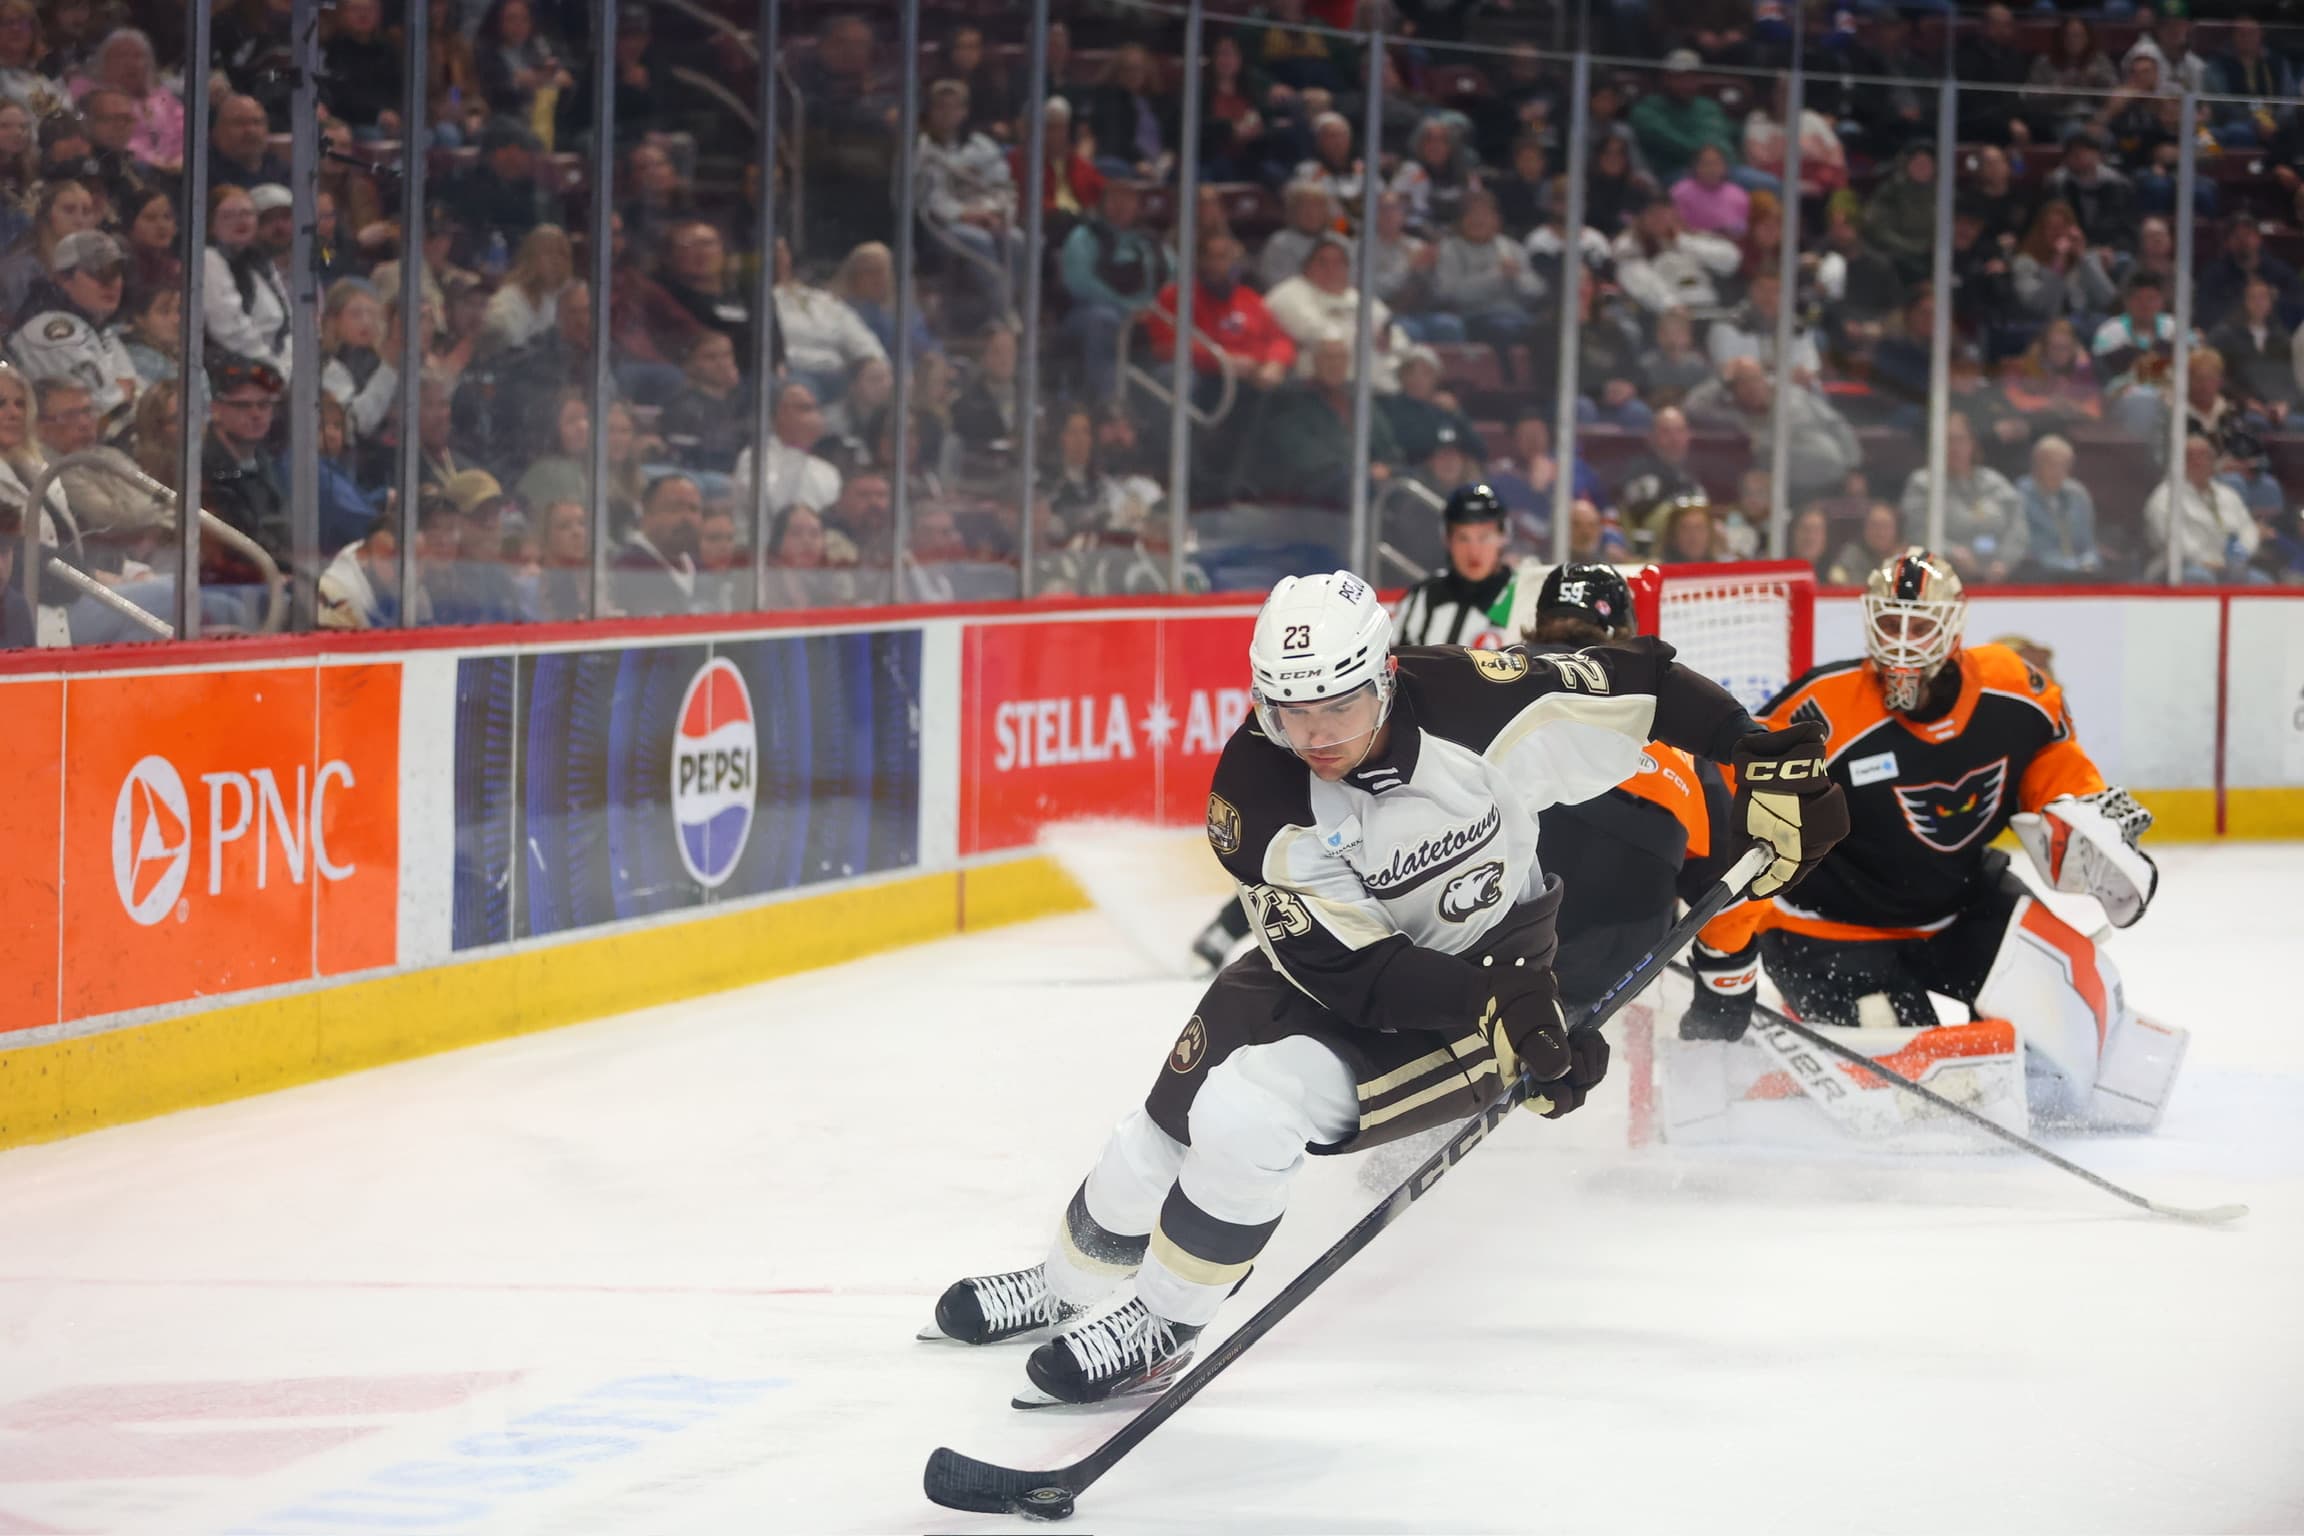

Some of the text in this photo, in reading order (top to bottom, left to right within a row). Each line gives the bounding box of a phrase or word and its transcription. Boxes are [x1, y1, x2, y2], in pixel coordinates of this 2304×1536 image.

[1558, 582, 1585, 603] 59
[1283, 625, 1311, 650] 23
[1280, 669, 1322, 680] CCM
[994, 689, 1252, 771] STELLA AR
[679, 746, 751, 797] PEPSI
[1662, 767, 1690, 797] CCM
[1744, 758, 1828, 781] CCM
[200, 760, 357, 896] PNC
[1248, 882, 1313, 942] 23
[1409, 1078, 1527, 1202] CCM
[1207, 1343, 1244, 1377] KICKPOINT
